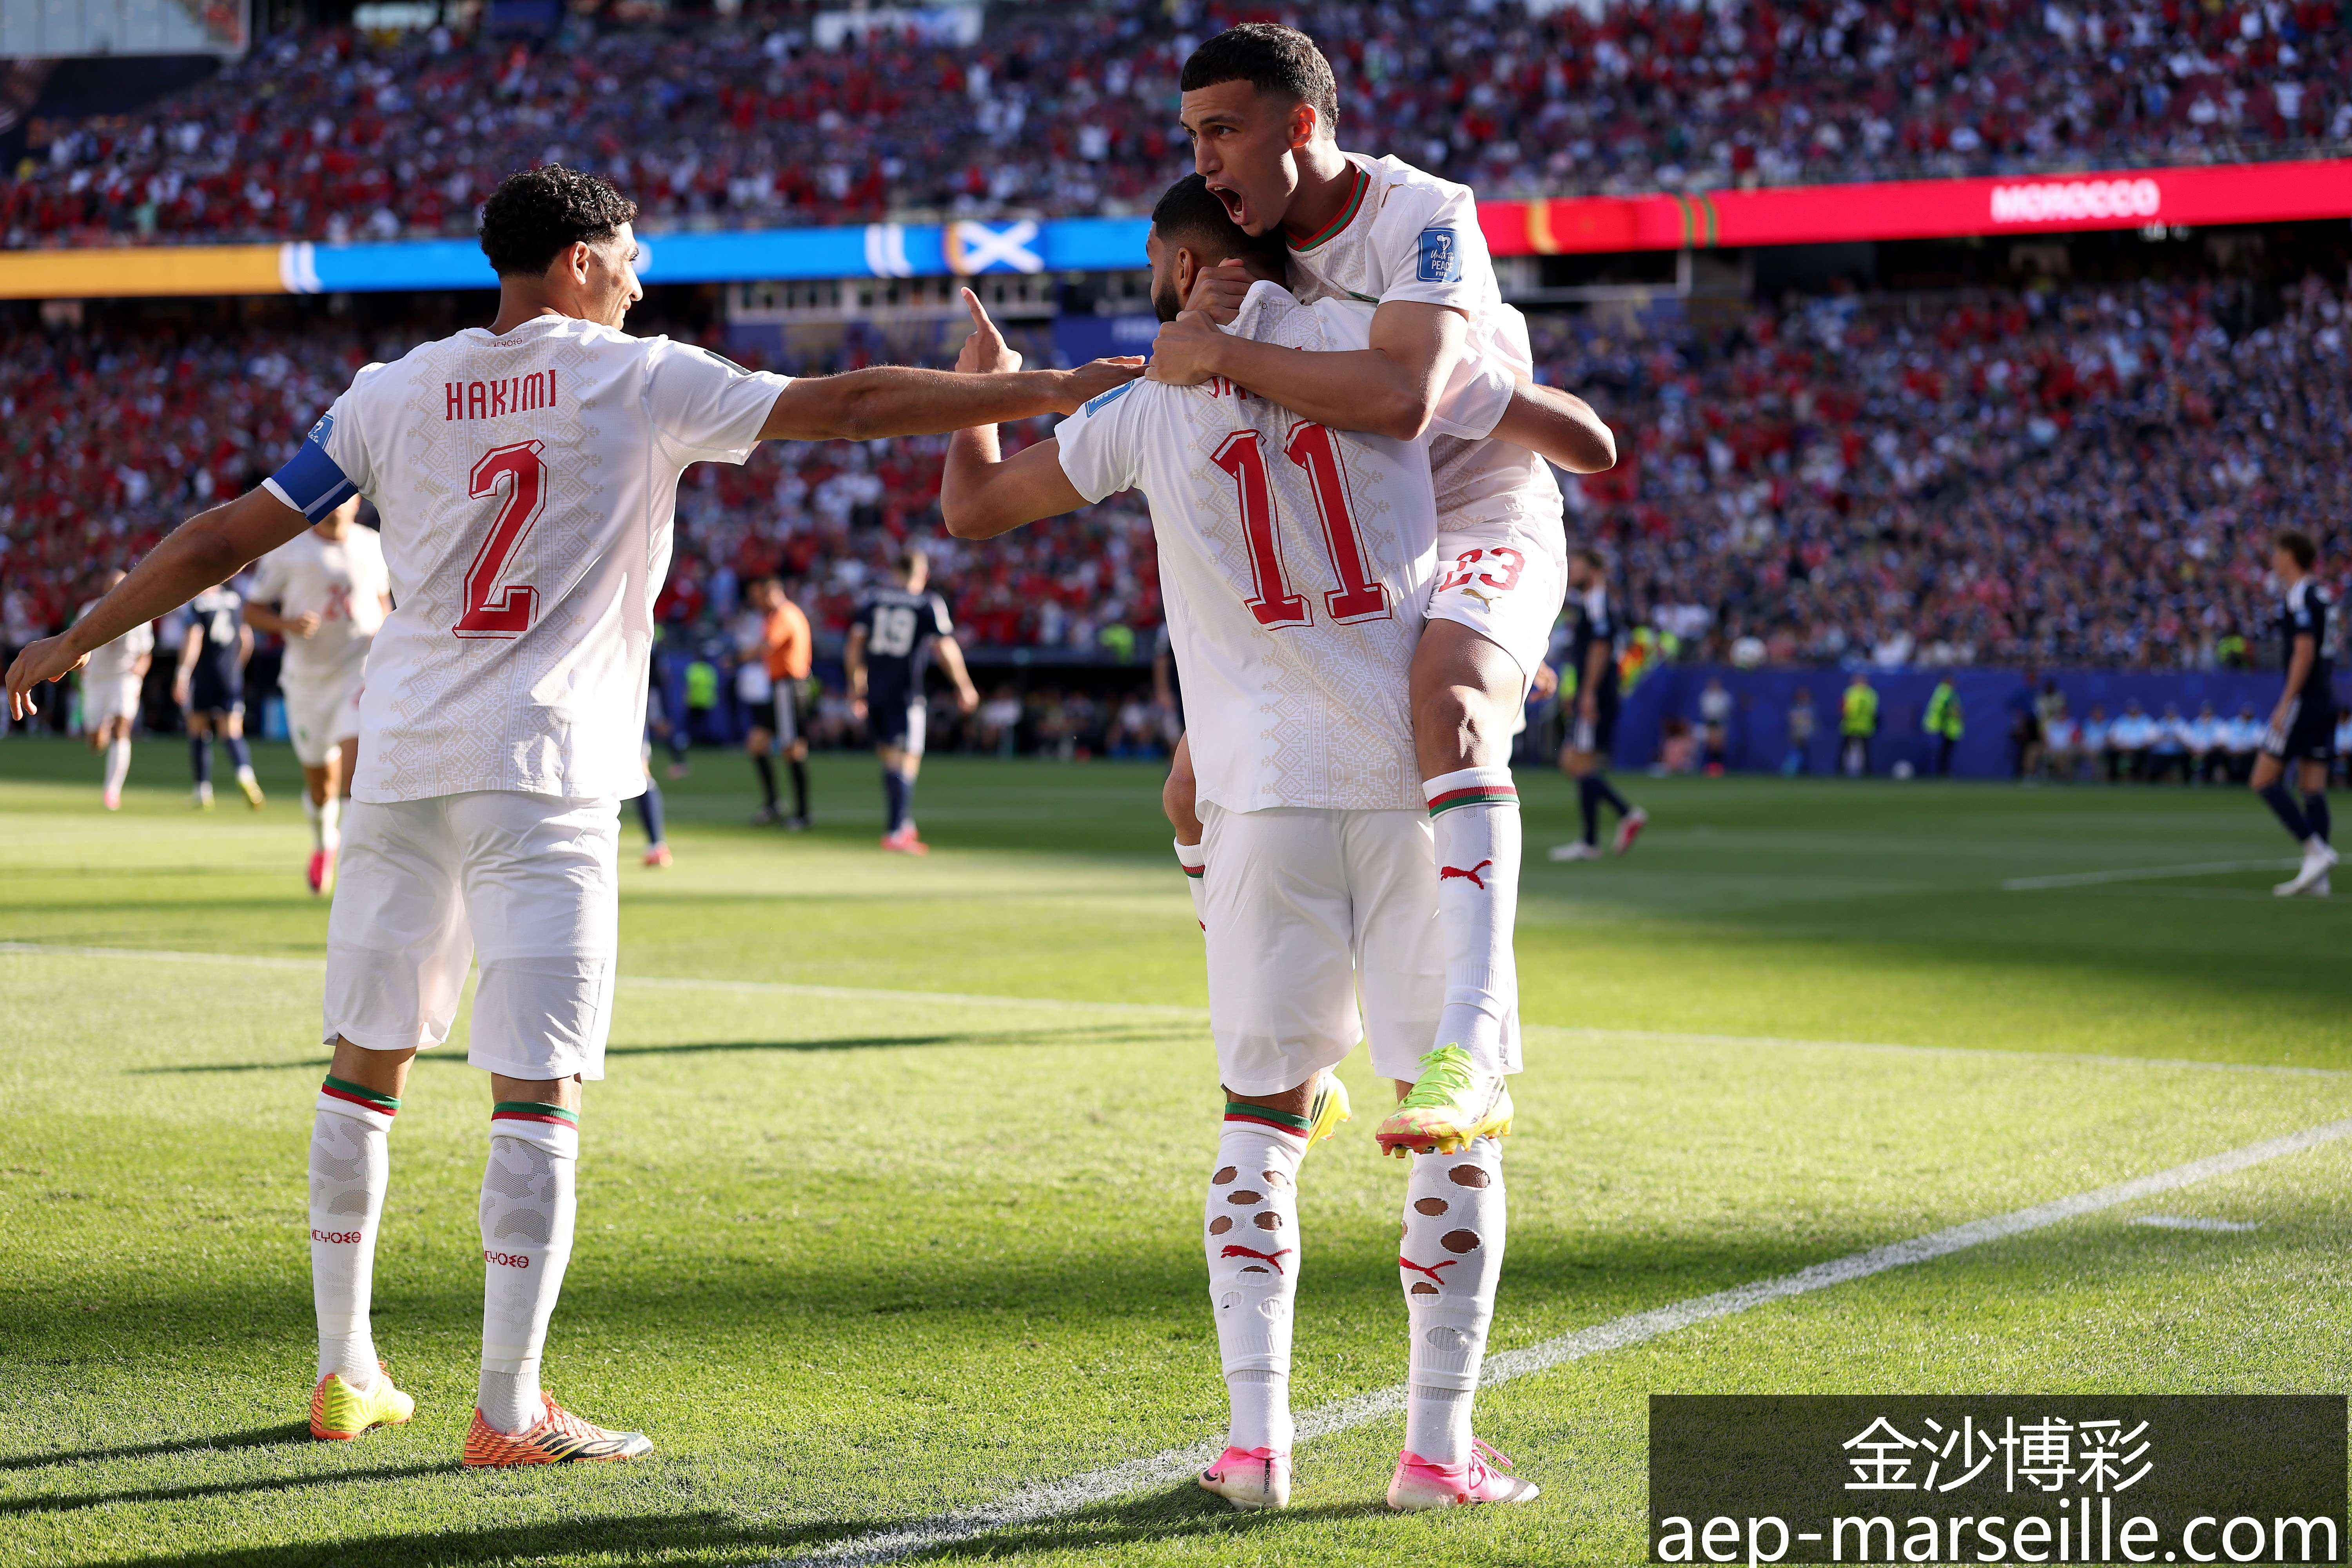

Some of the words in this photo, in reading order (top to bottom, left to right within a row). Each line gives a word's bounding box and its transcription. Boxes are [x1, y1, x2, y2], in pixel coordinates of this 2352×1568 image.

[1432, 260, 1453, 272] PEACE
[445, 369, 556, 421] HAKIMI
[452, 439, 547, 639] 2
[1210, 418, 1392, 631] 11
[1438, 547, 1526, 592] 23
[867, 606, 918, 657] 19
[1398, 1465, 1406, 1488] VAPOR
